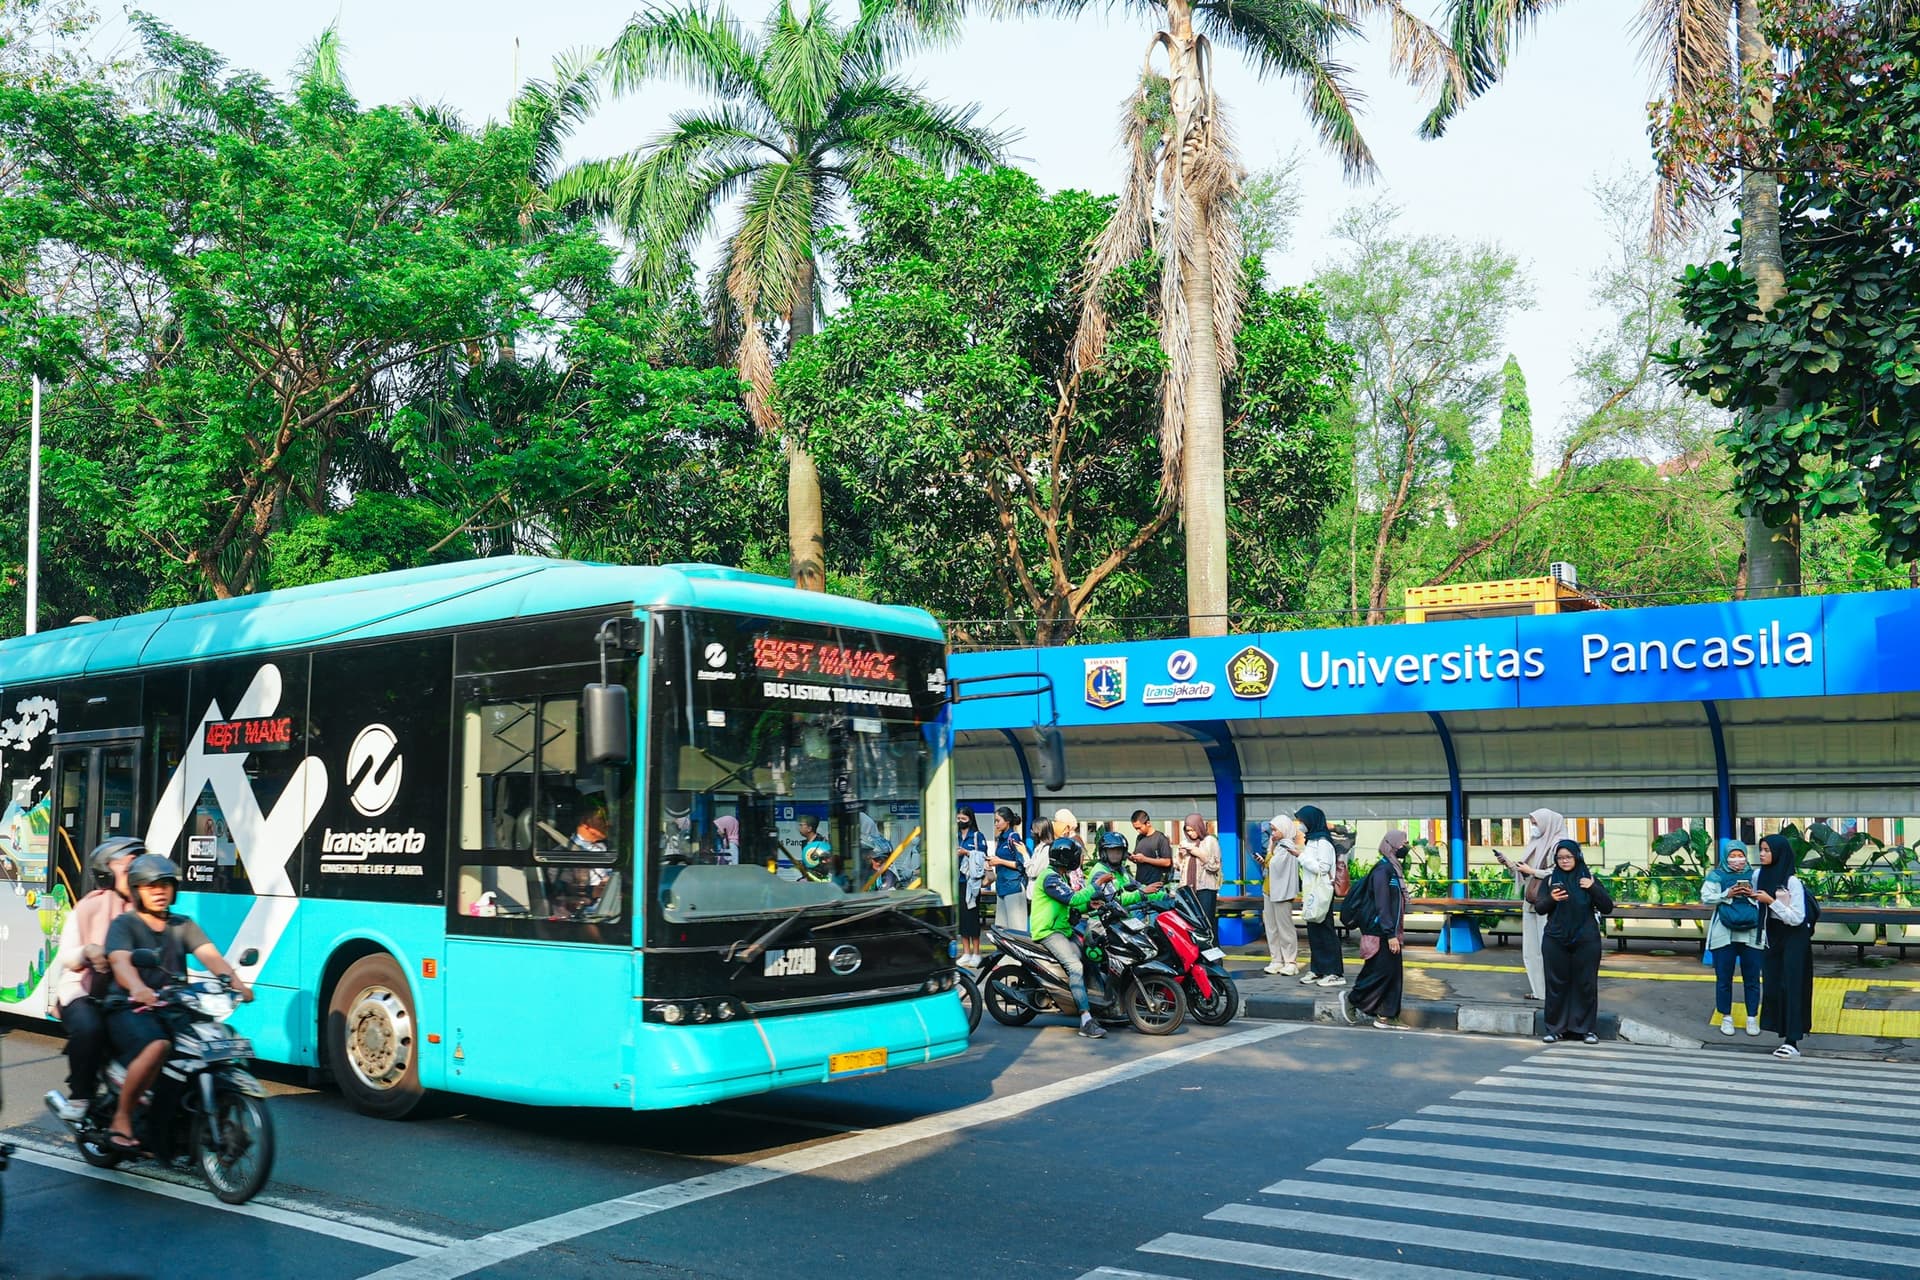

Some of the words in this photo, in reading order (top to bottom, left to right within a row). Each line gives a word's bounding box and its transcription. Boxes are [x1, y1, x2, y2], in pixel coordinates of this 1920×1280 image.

[1300, 643, 1546, 689] Universitas
[1582, 620, 1814, 675] Pancasila
[763, 682, 789, 698] BUS
[790, 684, 831, 701] LISTRIK
[1145, 684, 1210, 700] transjakarta
[320, 827, 426, 861] transjakarta
